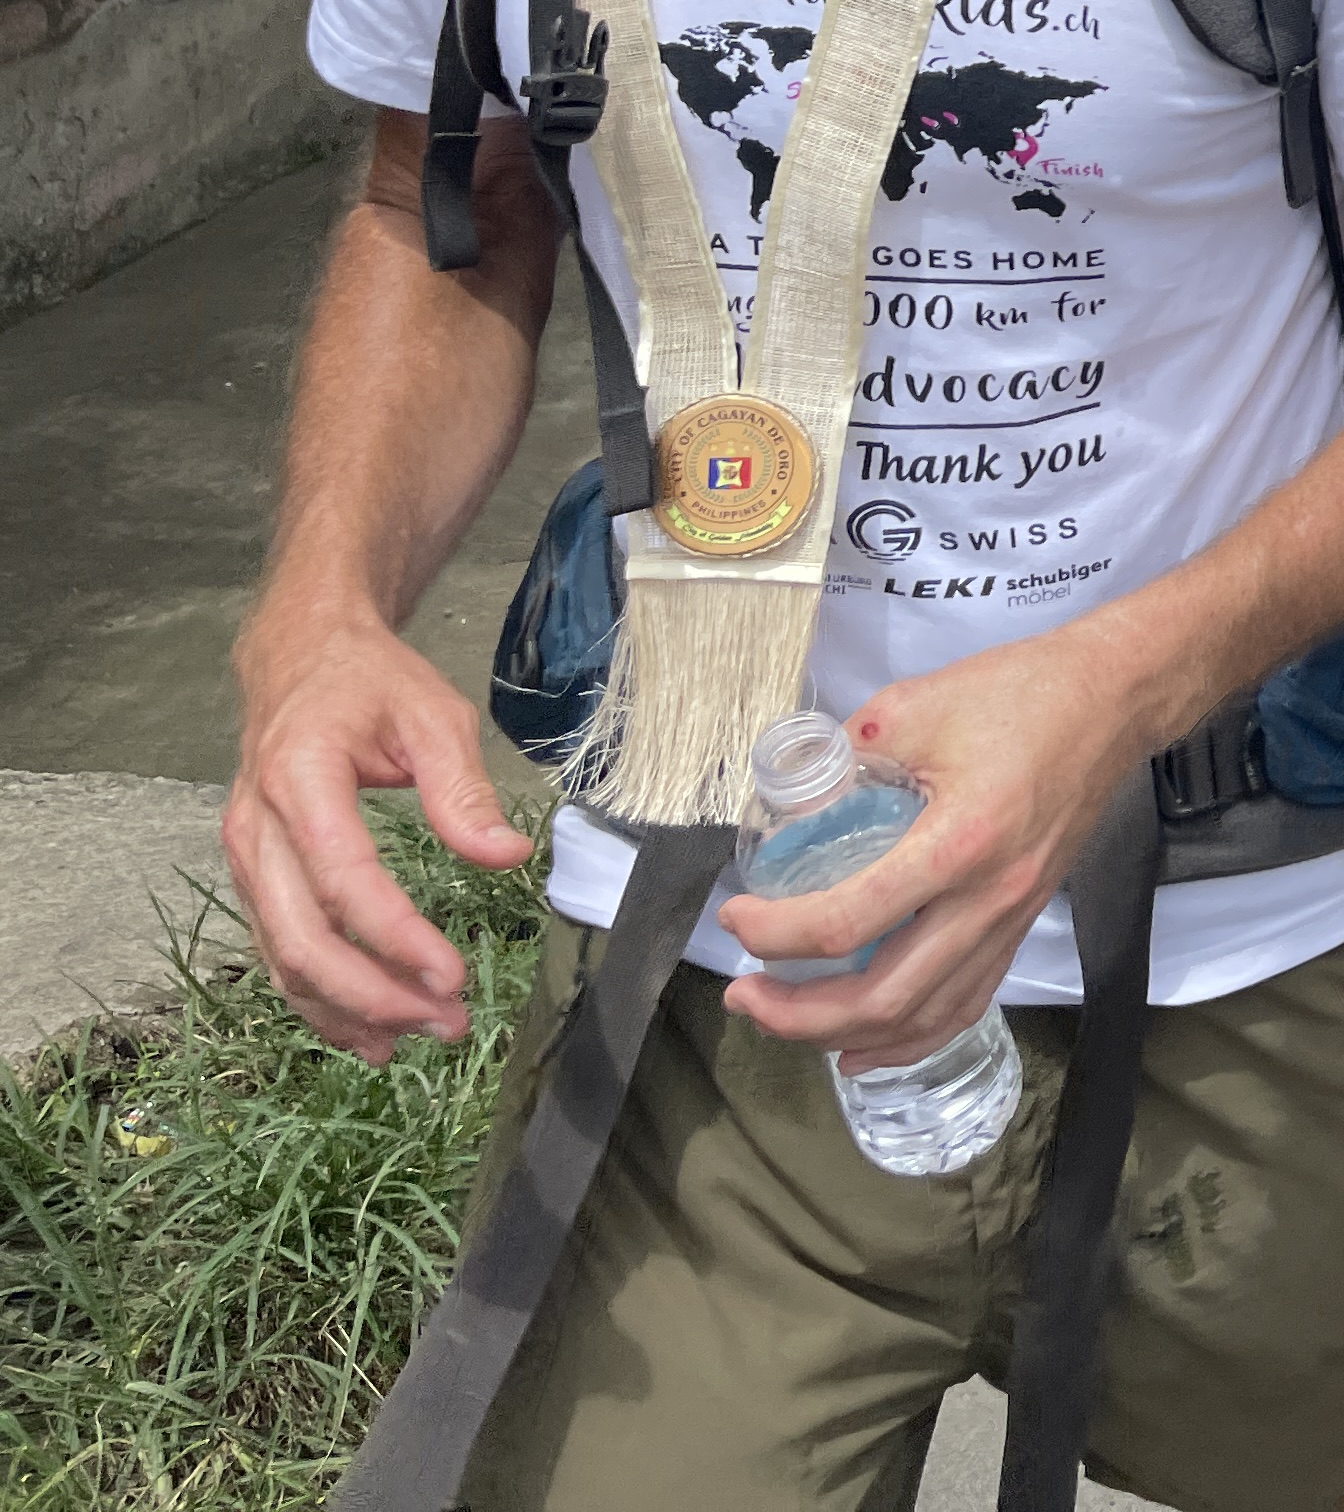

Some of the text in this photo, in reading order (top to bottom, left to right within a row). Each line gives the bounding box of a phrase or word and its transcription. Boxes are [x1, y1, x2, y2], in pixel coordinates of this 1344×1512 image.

[1035, 157, 1104, 178] Finish
[872, 245, 1106, 271] GOES HOME
[976, 300, 1029, 331] km
[1051, 290, 1107, 323] for
[855, 355, 1106, 408] dvocacy
[680, 427, 696, 446] OF
[696, 408, 768, 428] CAGAYAN
[767, 426, 784, 445] DE
[777, 449, 790, 481] ORO
[856, 434, 1107, 489] Thank you
[691, 499, 767, 519] PHILIPPINES
[939, 517, 1078, 551] SWISS
[883, 574, 997, 599] LEKI
[1006, 556, 1112, 591] schubiger
[1007, 582, 1071, 609] möbel
